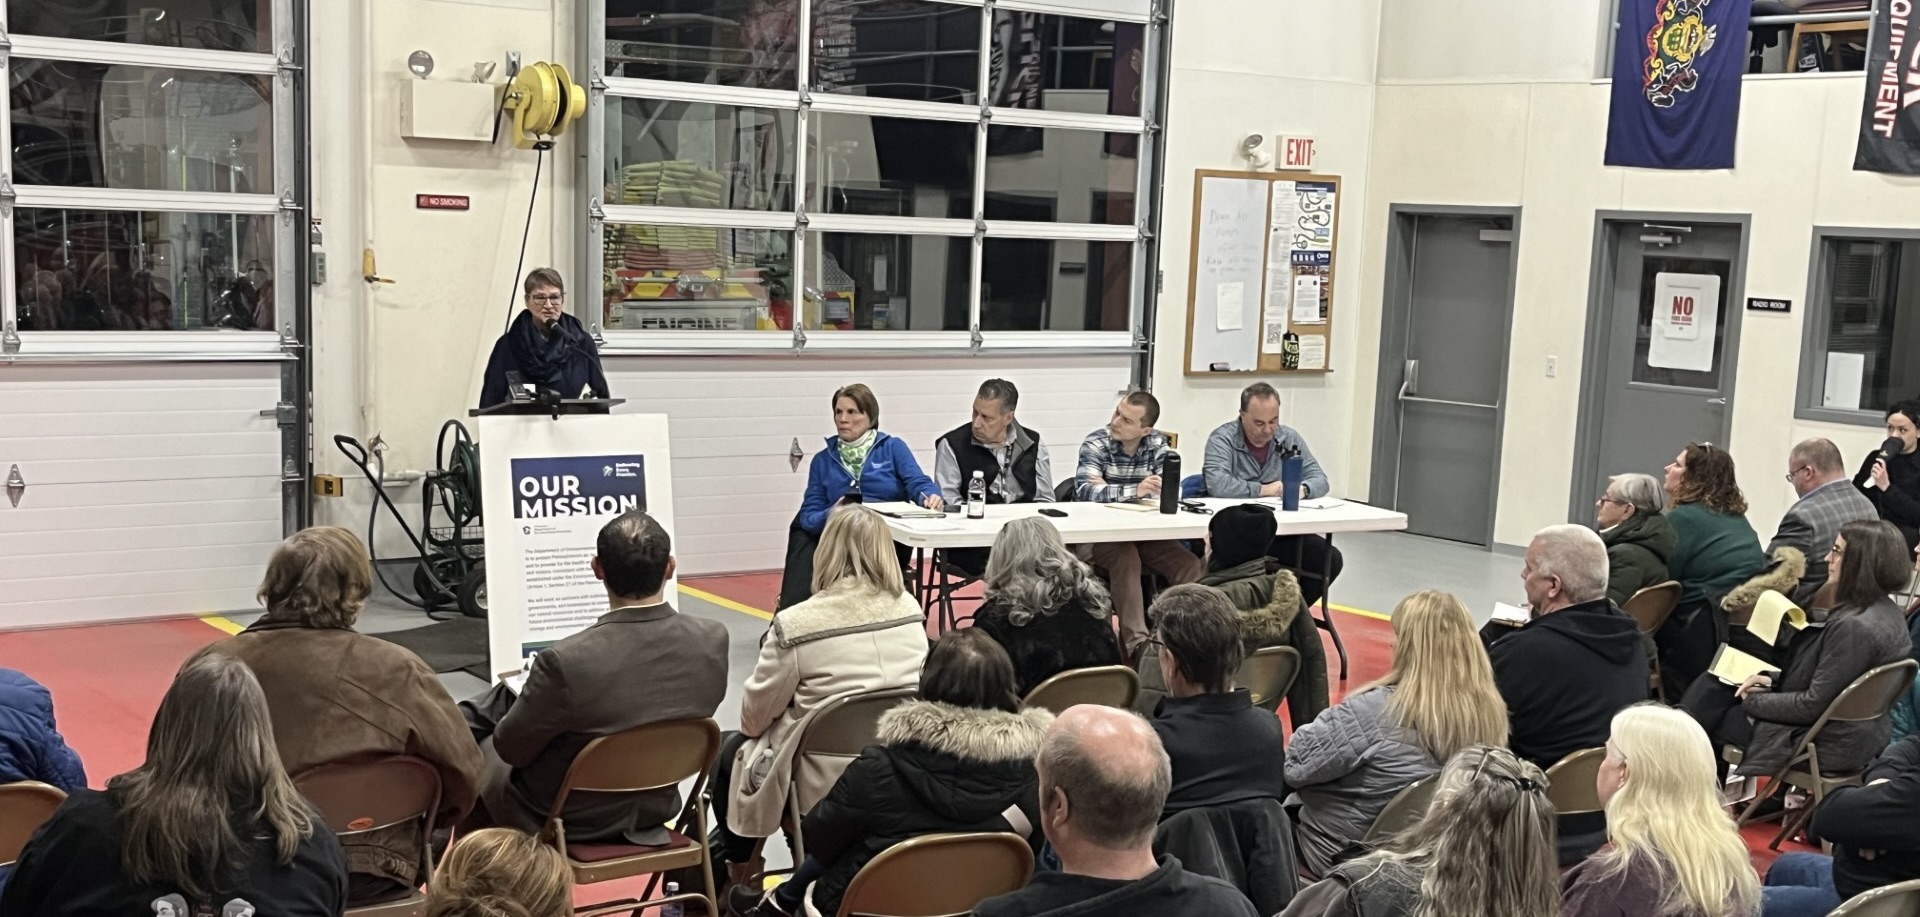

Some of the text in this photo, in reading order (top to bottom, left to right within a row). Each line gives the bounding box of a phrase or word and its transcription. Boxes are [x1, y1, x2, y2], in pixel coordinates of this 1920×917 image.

[1286, 138, 1314, 166] EXIT
[429, 197, 468, 206] NO SMOKING
[1672, 295, 1694, 316] NO
[1752, 300, 1786, 309] RADIO ROOM
[519, 474, 580, 498] OUR
[520, 494, 638, 519] MISSION
